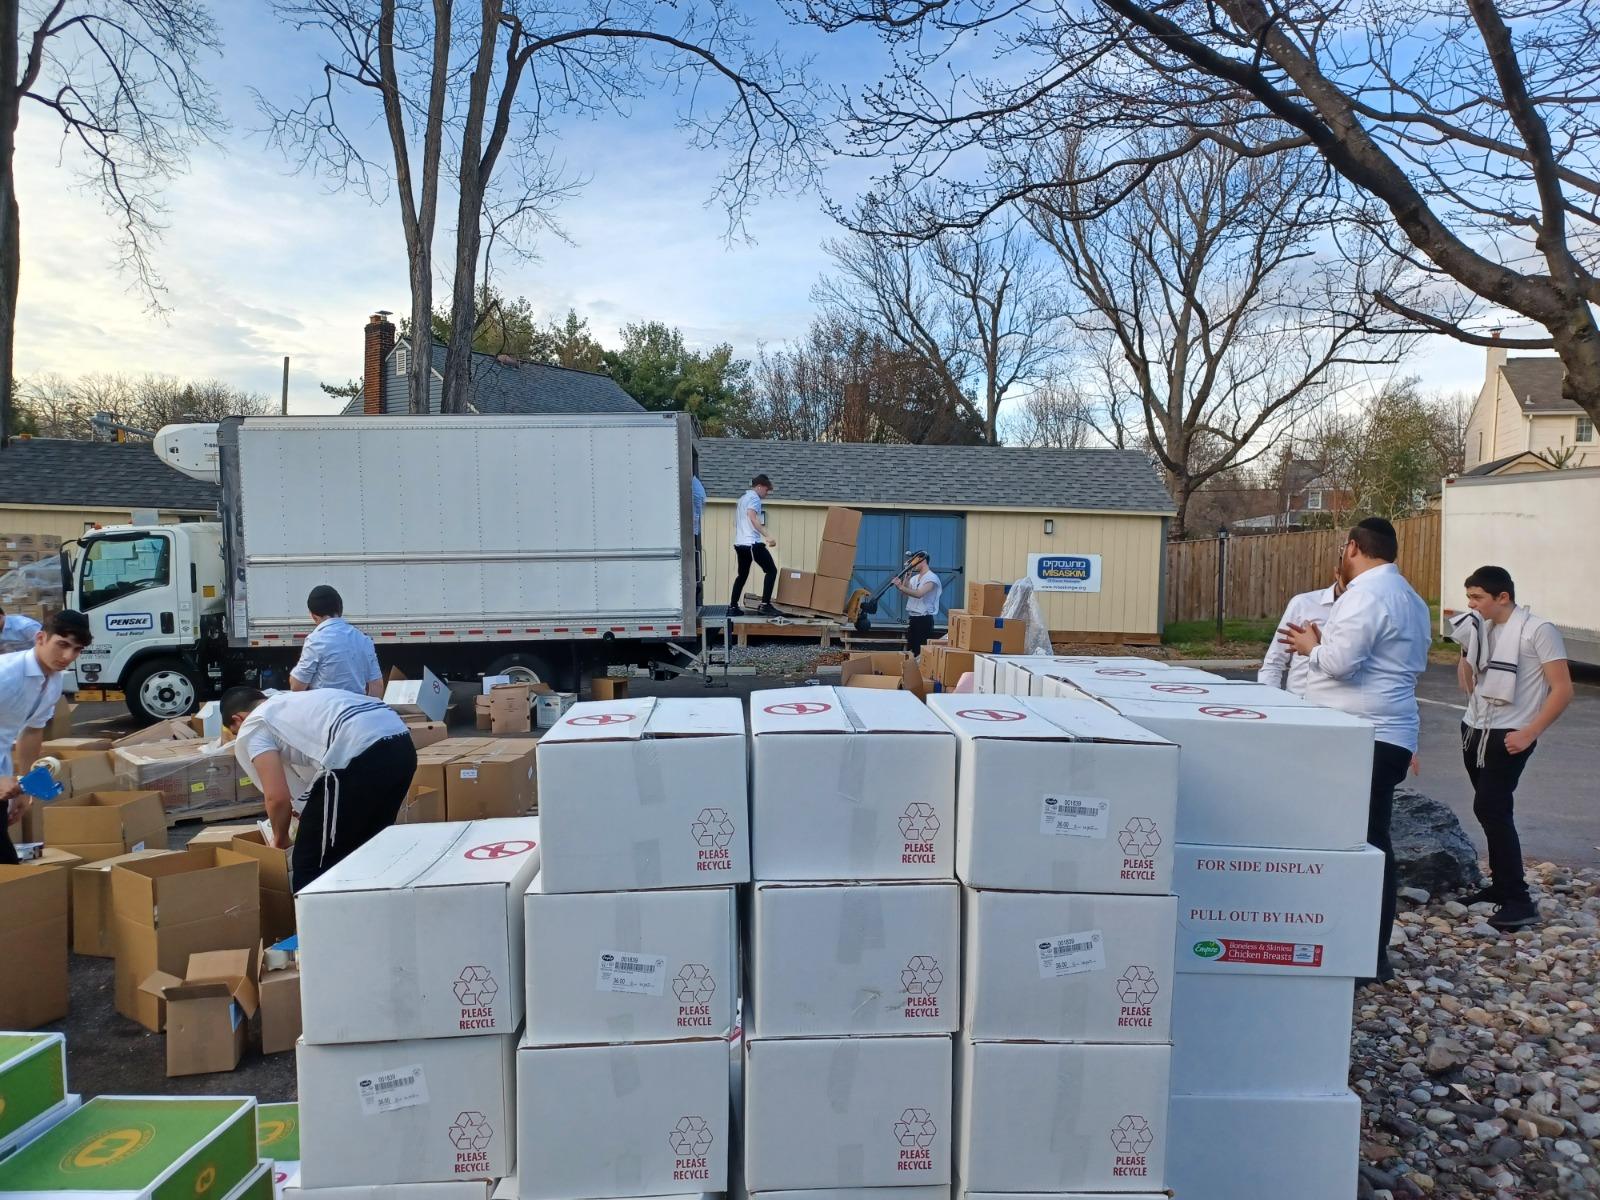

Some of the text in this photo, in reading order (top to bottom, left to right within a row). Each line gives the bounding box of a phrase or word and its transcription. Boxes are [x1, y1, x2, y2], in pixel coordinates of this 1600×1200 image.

[1043, 560, 1086, 570] מתעסקים
[109, 617, 149, 626] PENSKE
[905, 843, 933, 852] PLEASE
[699, 850, 729, 859] PLEASE
[902, 854, 935, 863] RECYCLE
[697, 860, 731, 870] RECYCLE
[1124, 859, 1153, 869] PLEASE
[1197, 859, 1325, 874] FOR SIDE DISPLAY
[1121, 870, 1155, 880] RECYCLE
[1190, 909, 1324, 924] PULL OUT BY HAND
[1195, 944, 1218, 956] Empire
[1229, 941, 1258, 950] Boneless
[1266, 944, 1292, 952] Skinless
[1228, 949, 1260, 959] Chicken
[1263, 951, 1292, 961] Breasts
[908, 997, 936, 1006] PLEASE
[462, 1008, 491, 1018] PLEASE
[680, 1006, 709, 1015] PLEASE
[906, 1008, 938, 1017] RECYCLE
[1121, 1007, 1150, 1016] PLEASE
[460, 1019, 495, 1029] RECYCLE
[678, 1017, 711, 1026] RECYCLE
[1118, 1017, 1152, 1026] RECYCLE
[457, 1152, 487, 1161] PLEASE
[900, 1150, 929, 1159] PLEASE
[676, 1158, 706, 1168] PLEASE
[898, 1161, 931, 1170] RECYCLE
[1116, 1157, 1145, 1166] PLEASE
[455, 1162, 489, 1172] RECYCLE
[1113, 1166, 1147, 1176] RECYCLE
[674, 1169, 708, 1179] RECYCLE
